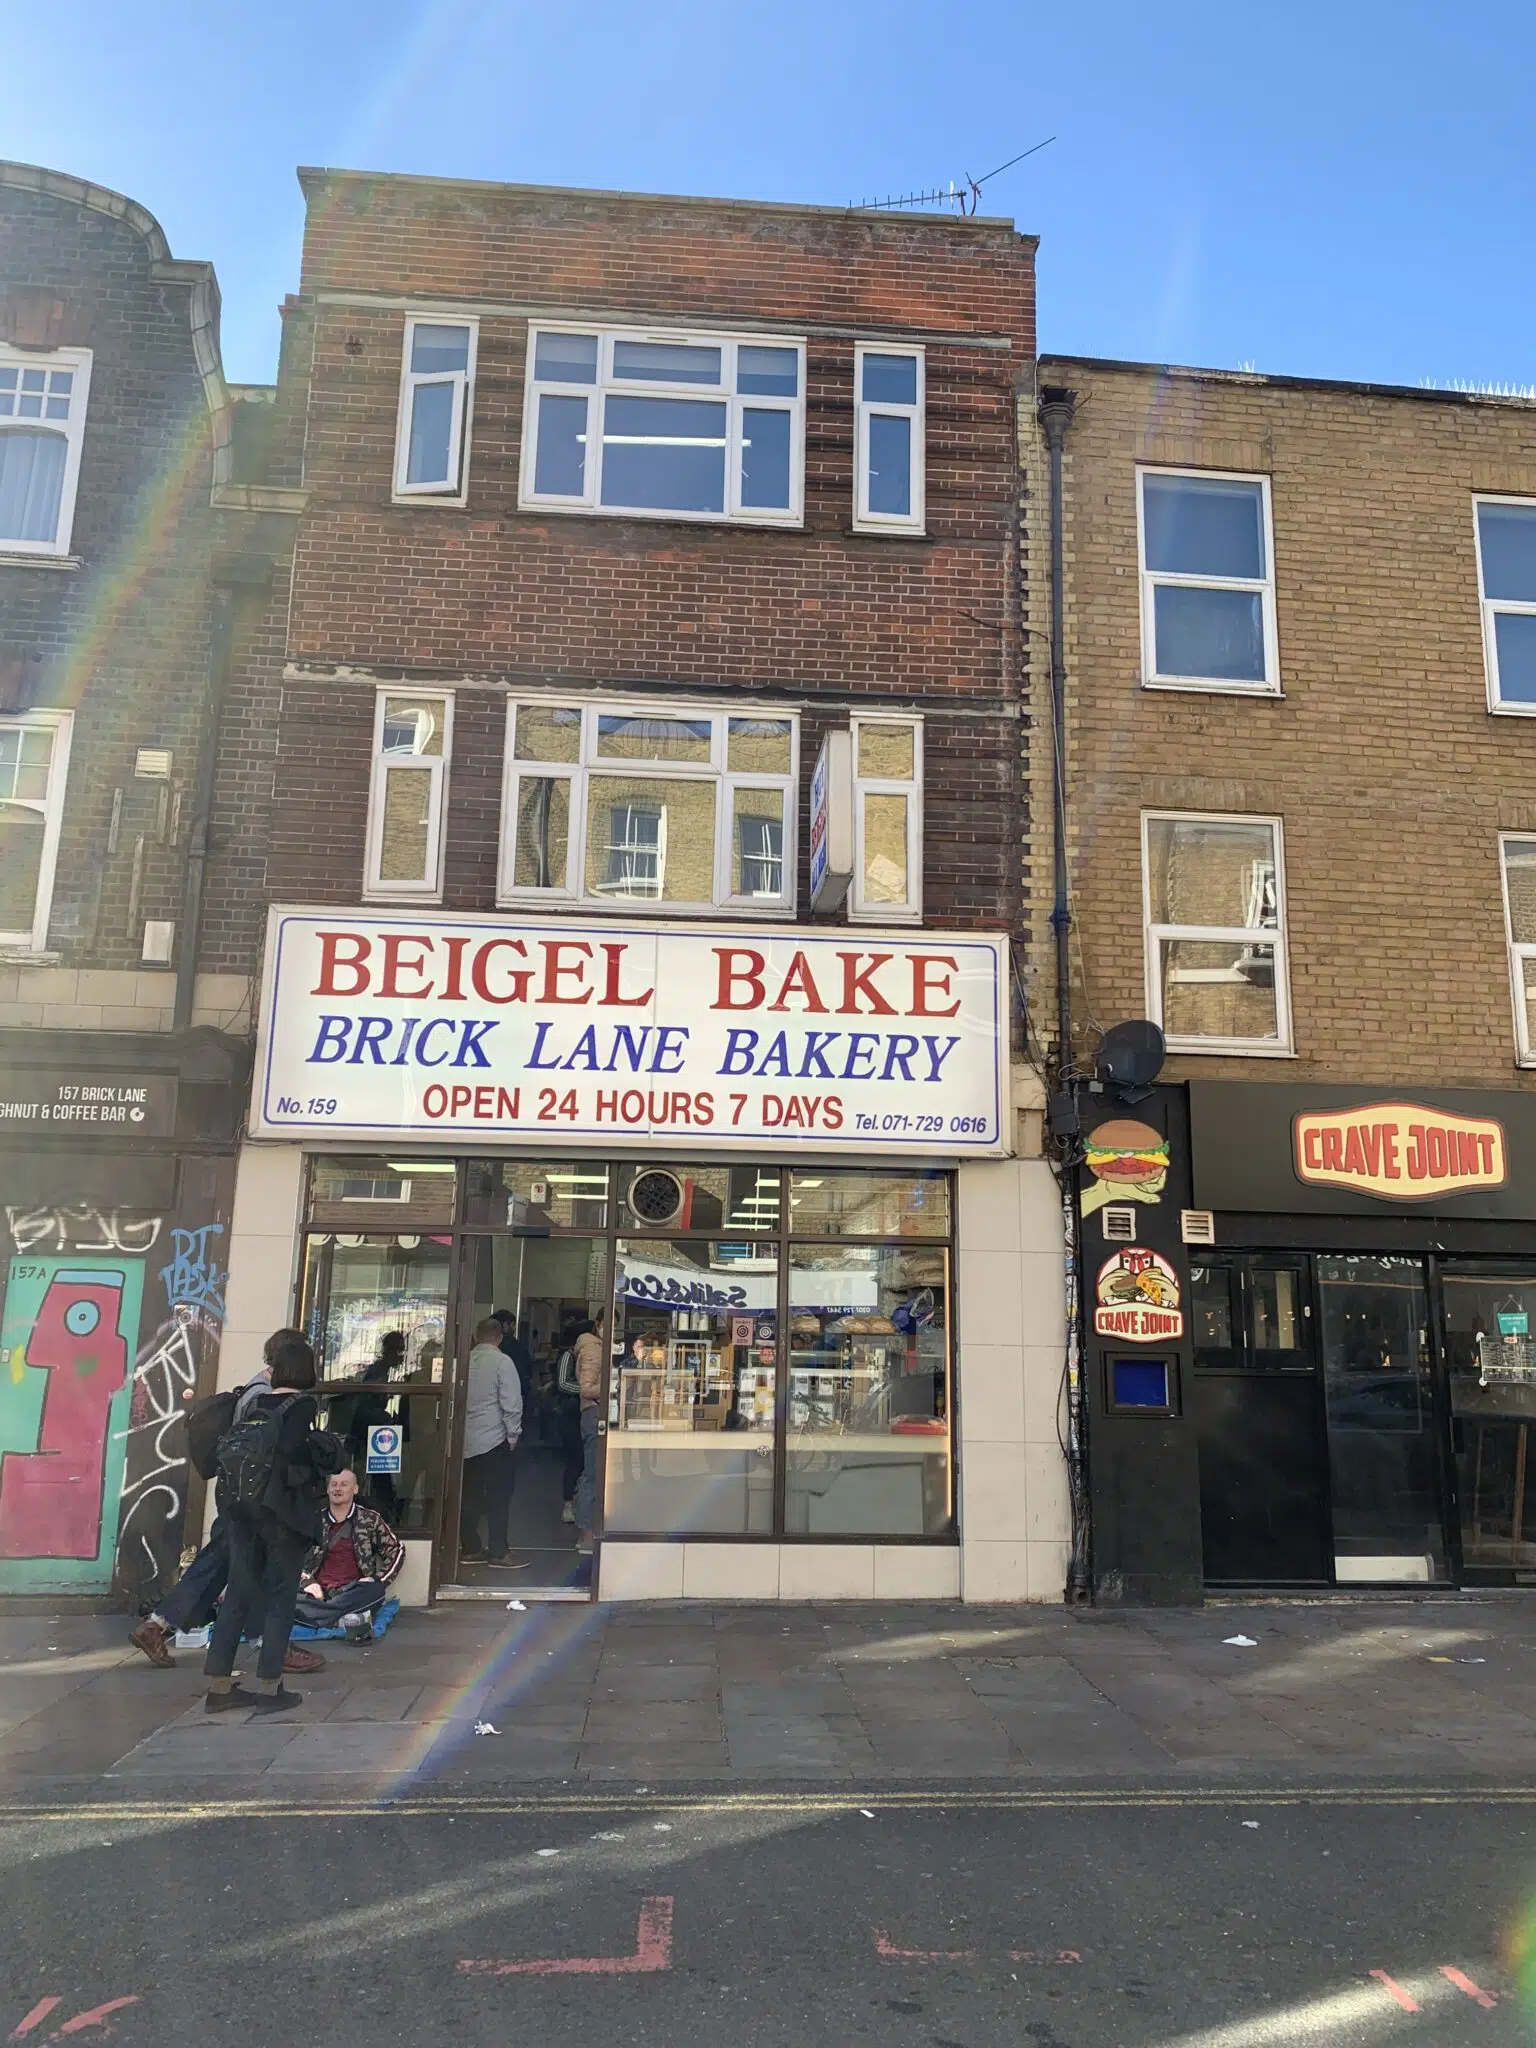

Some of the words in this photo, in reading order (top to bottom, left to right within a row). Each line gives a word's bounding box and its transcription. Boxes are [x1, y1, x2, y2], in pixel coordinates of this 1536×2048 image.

[310, 932, 654, 1006] BEIGEL
[709, 948, 961, 1017] BAKE
[305, 1015, 500, 1068] BRICK
[523, 1022, 690, 1074] LANE
[716, 1028, 961, 1082] BAKERY
[59, 1086, 79, 1100] 157
[81, 1087, 116, 1101] BRICK
[118, 1088, 147, 1102] LANE
[41, 1104, 50, 1119] &
[53, 1105, 98, 1121] COFFEE
[100, 1106, 126, 1121] BAR
[423, 1084, 520, 1119] OPEN
[537, 1087, 579, 1121] 24
[596, 1089, 714, 1126] HOURS
[729, 1094, 748, 1126] 7
[762, 1094, 844, 1130] DAYS
[950, 1116, 987, 1133] 0616
[1303, 1123, 1400, 1180] CRAVE
[1407, 1124, 1496, 1180] JOINT
[12, 1266, 47, 1280] 157A
[1098, 1311, 1139, 1335] CRAVE
[1141, 1312, 1180, 1335] JOINT
